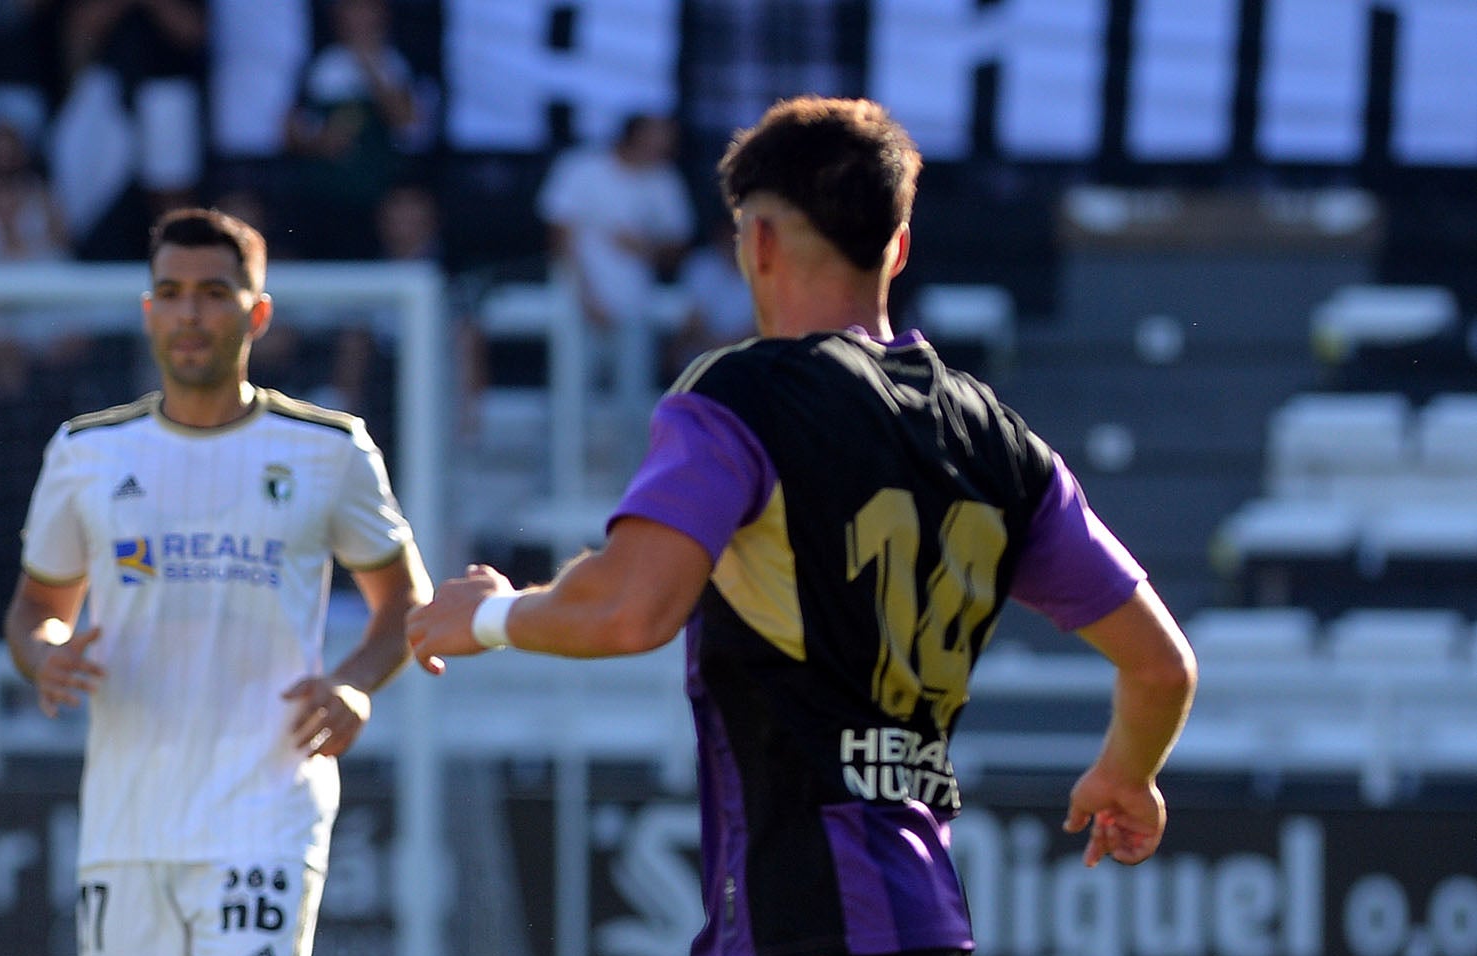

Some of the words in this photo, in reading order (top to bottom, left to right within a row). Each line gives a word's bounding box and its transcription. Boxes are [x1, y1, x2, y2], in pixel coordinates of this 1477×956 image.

[162, 533, 286, 566] REALE
[162, 566, 281, 588] SEGUROS
[221, 897, 284, 932] nb
